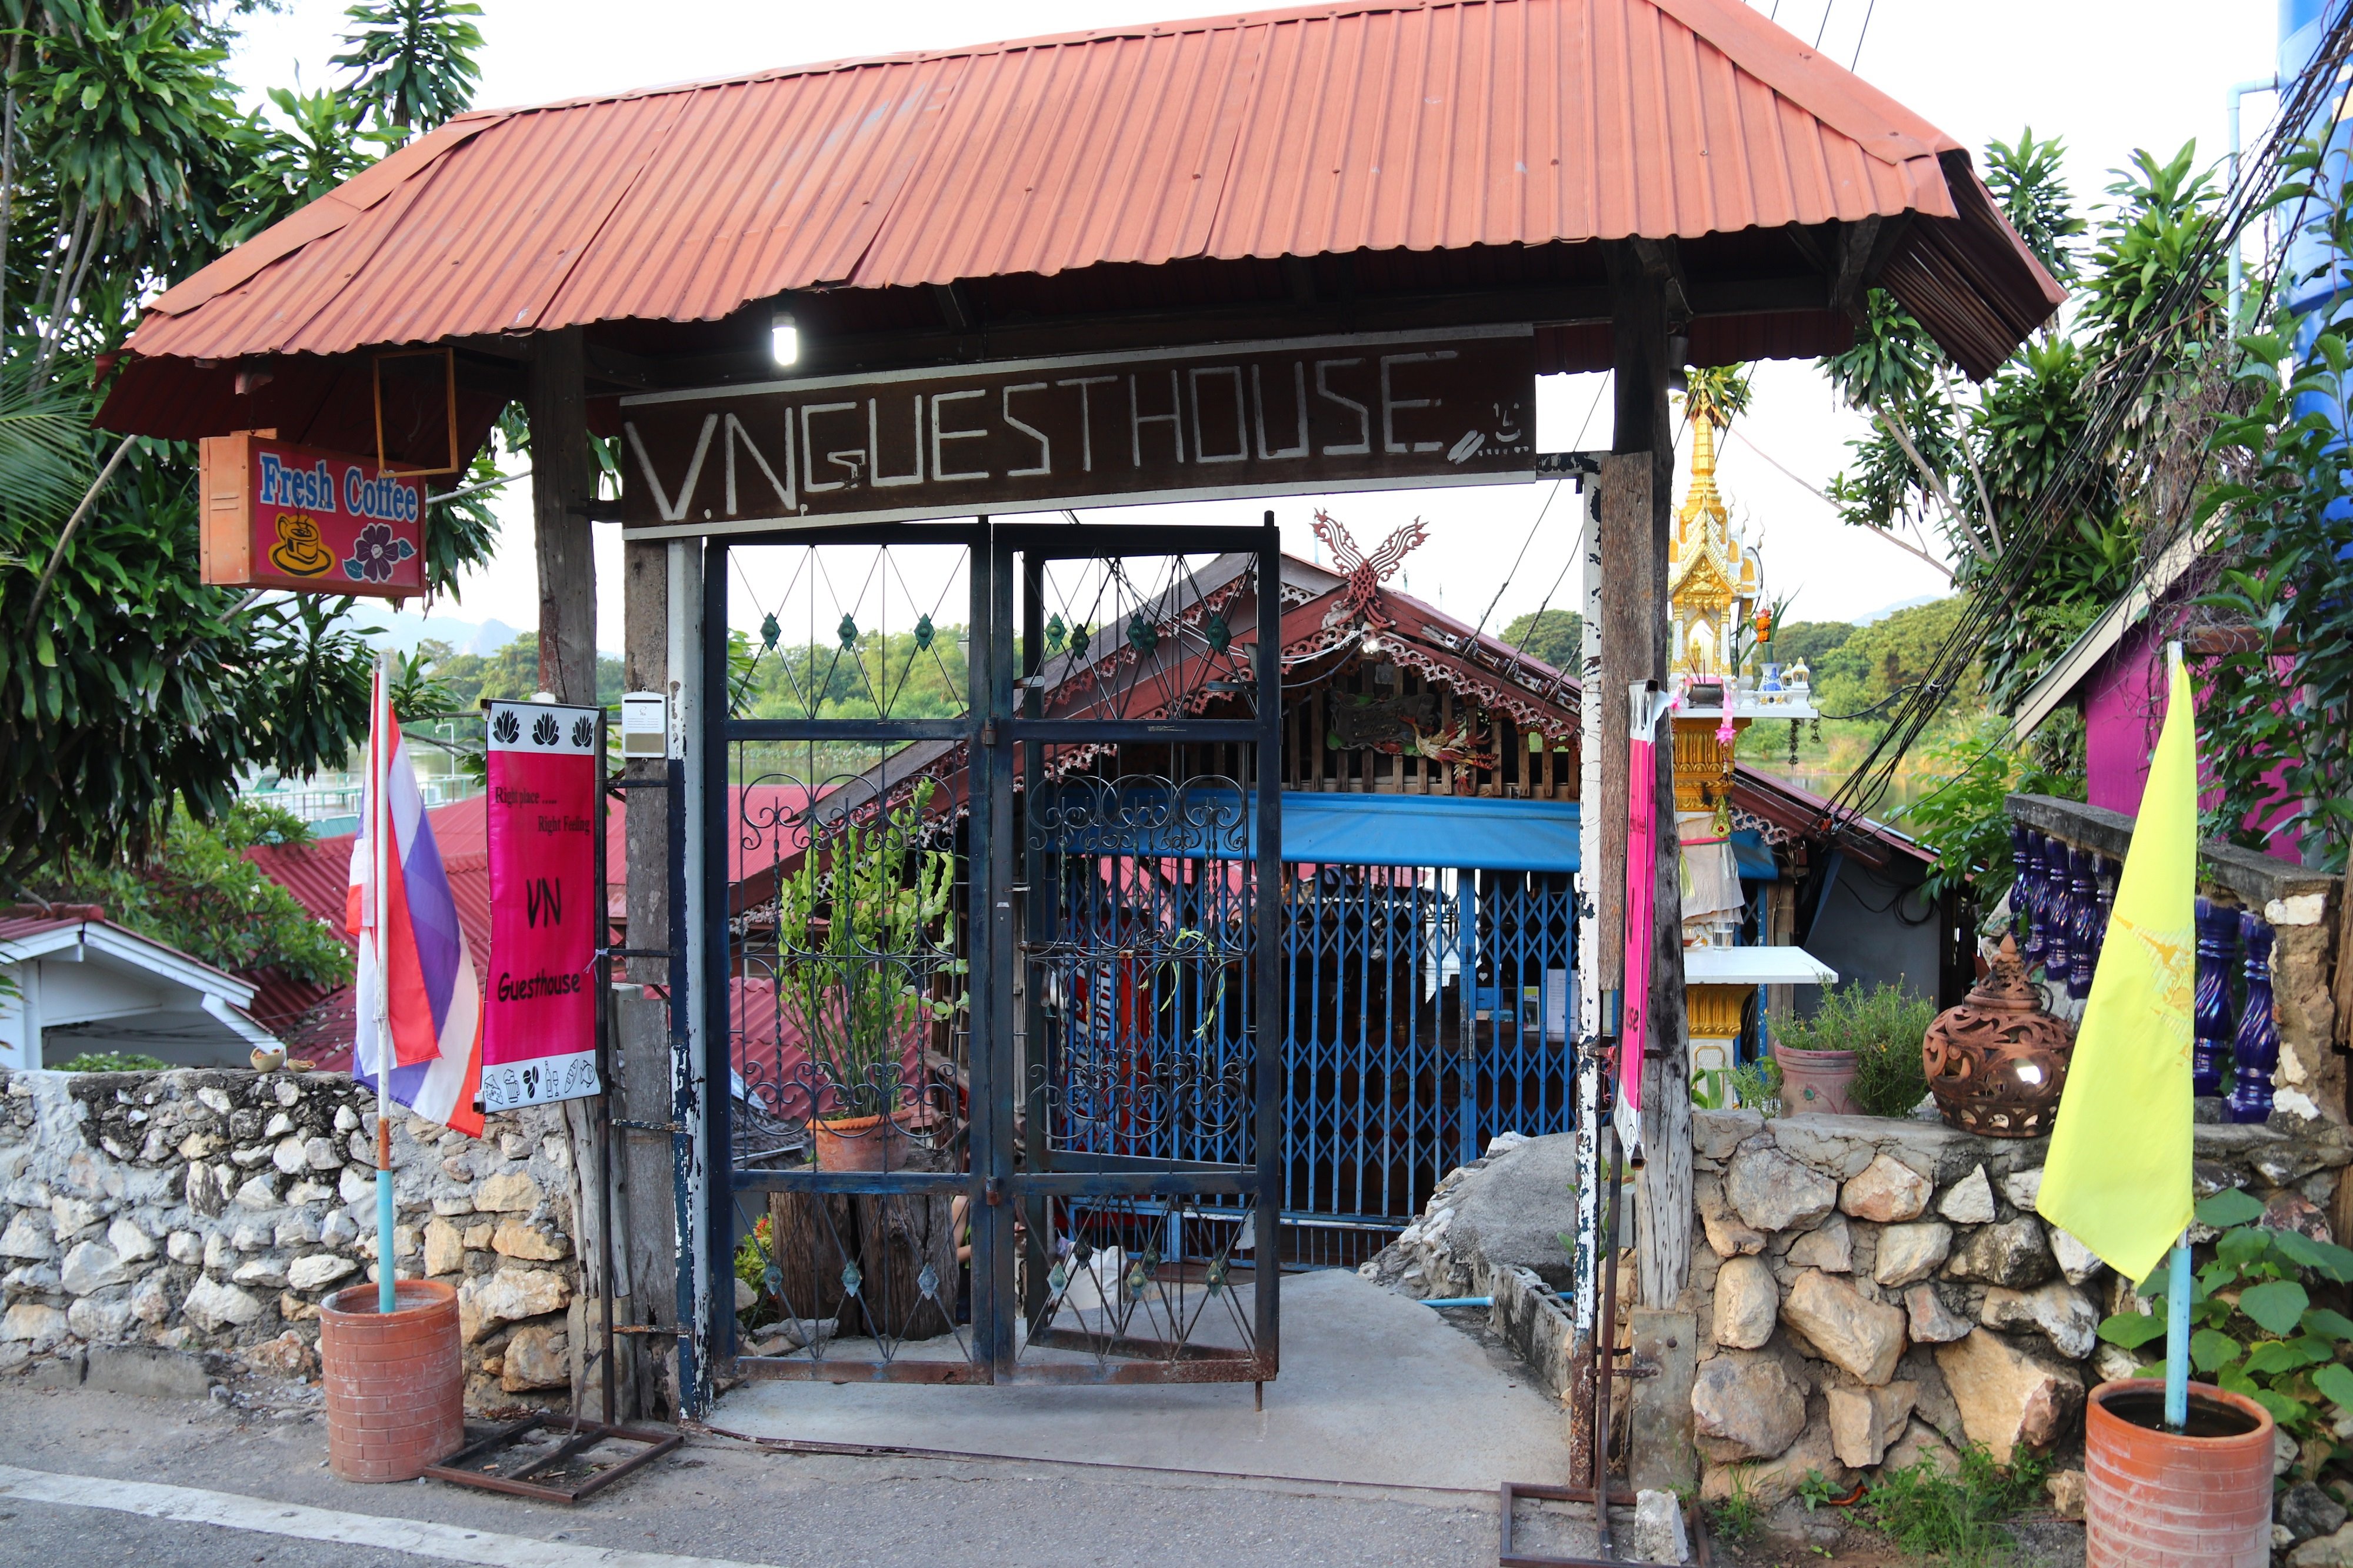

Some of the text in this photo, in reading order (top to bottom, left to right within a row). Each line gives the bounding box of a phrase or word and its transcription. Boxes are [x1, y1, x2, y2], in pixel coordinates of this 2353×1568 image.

[259, 452, 419, 523] Fresh Coffee
[495, 787, 518, 808] Right
[519, 788, 540, 808] place
[538, 816, 590, 836] Right Feeling
[526, 876, 561, 929] VN
[498, 969, 581, 1002] Guesthouse
